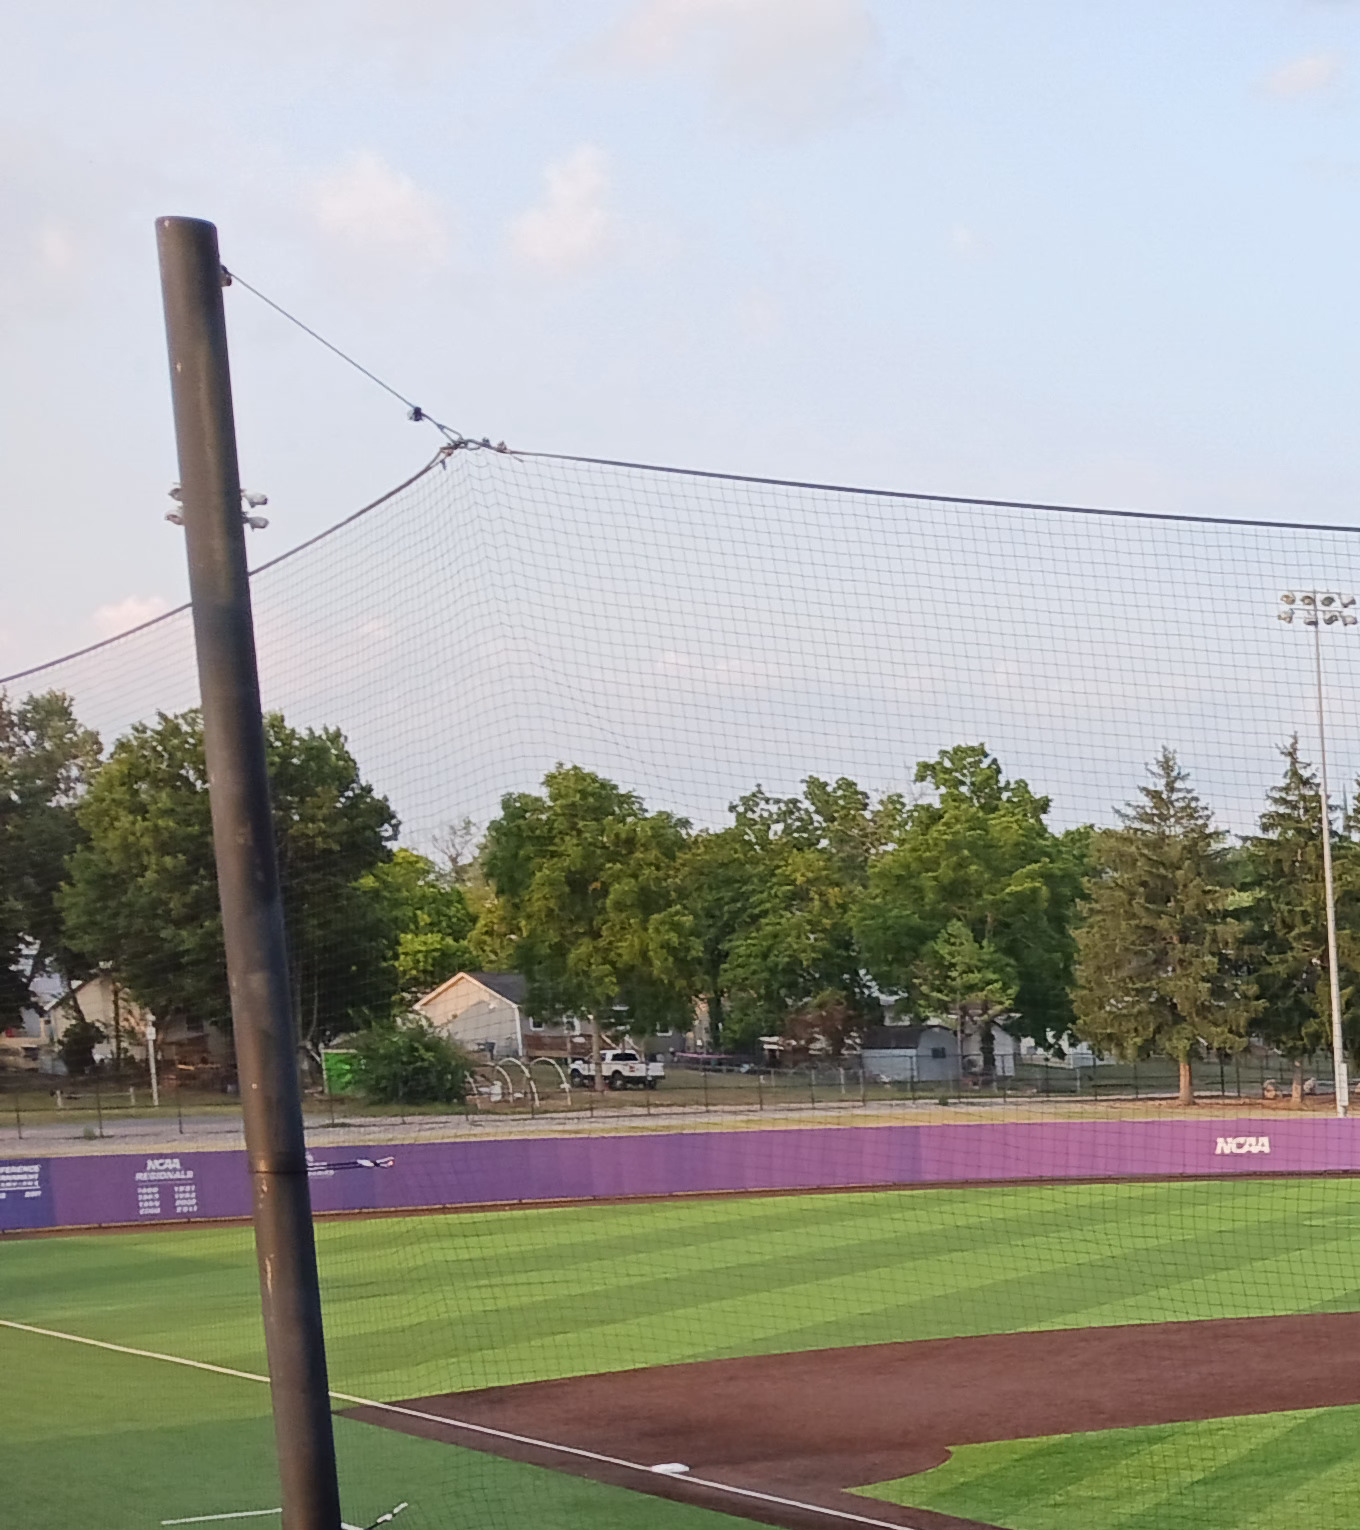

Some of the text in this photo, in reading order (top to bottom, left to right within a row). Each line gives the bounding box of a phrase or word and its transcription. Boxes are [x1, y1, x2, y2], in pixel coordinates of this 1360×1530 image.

[1215, 1136, 1271, 1155] NCAA
[146, 1158, 181, 1171] NCAA
[135, 1170, 194, 1181] REGIONALS
